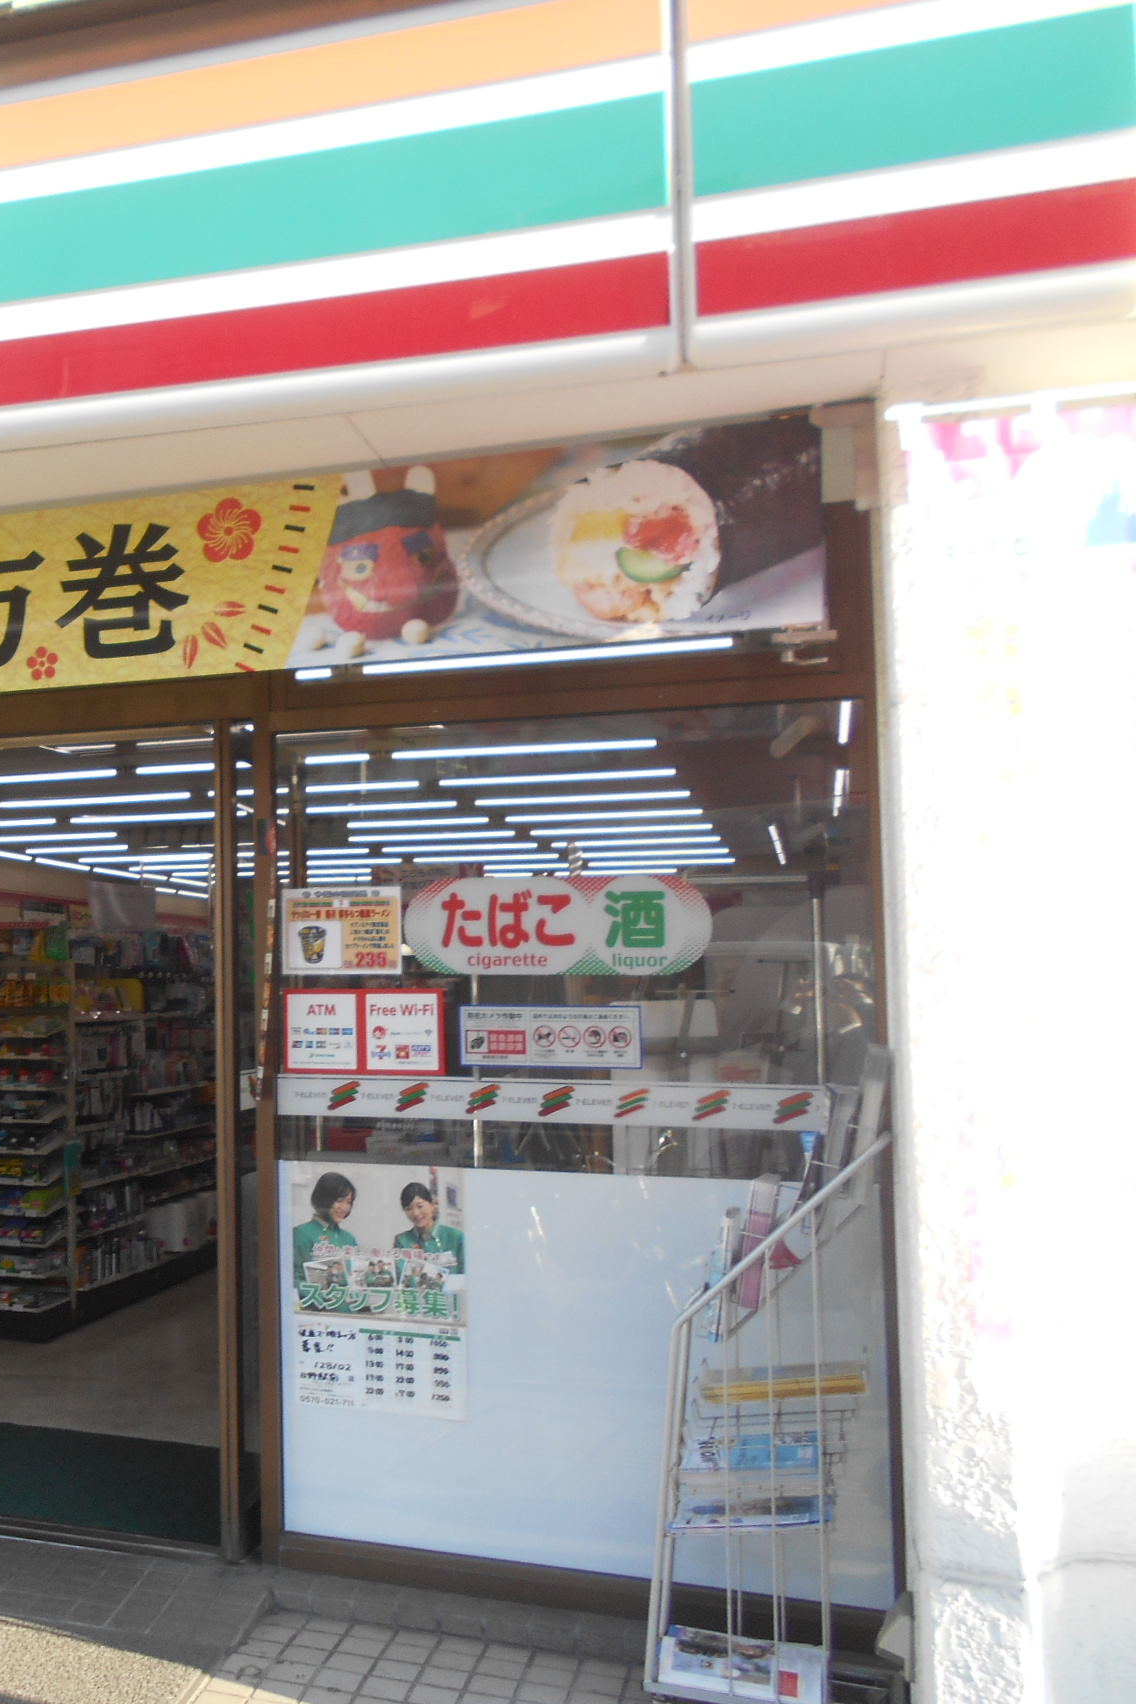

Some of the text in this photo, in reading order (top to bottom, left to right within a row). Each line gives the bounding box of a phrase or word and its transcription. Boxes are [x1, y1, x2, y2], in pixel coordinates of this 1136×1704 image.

[441, 889, 576, 949] たばこ
[604, 890, 666, 948] 酒
[355, 952, 387, 968] 235
[467, 952, 549, 970] cigarette
[612, 952, 667, 969] liquor
[307, 1004, 336, 1016] ATM
[369, 1003, 434, 1016] Free Wi-Fi
[314, 1361, 352, 1372] 128102
